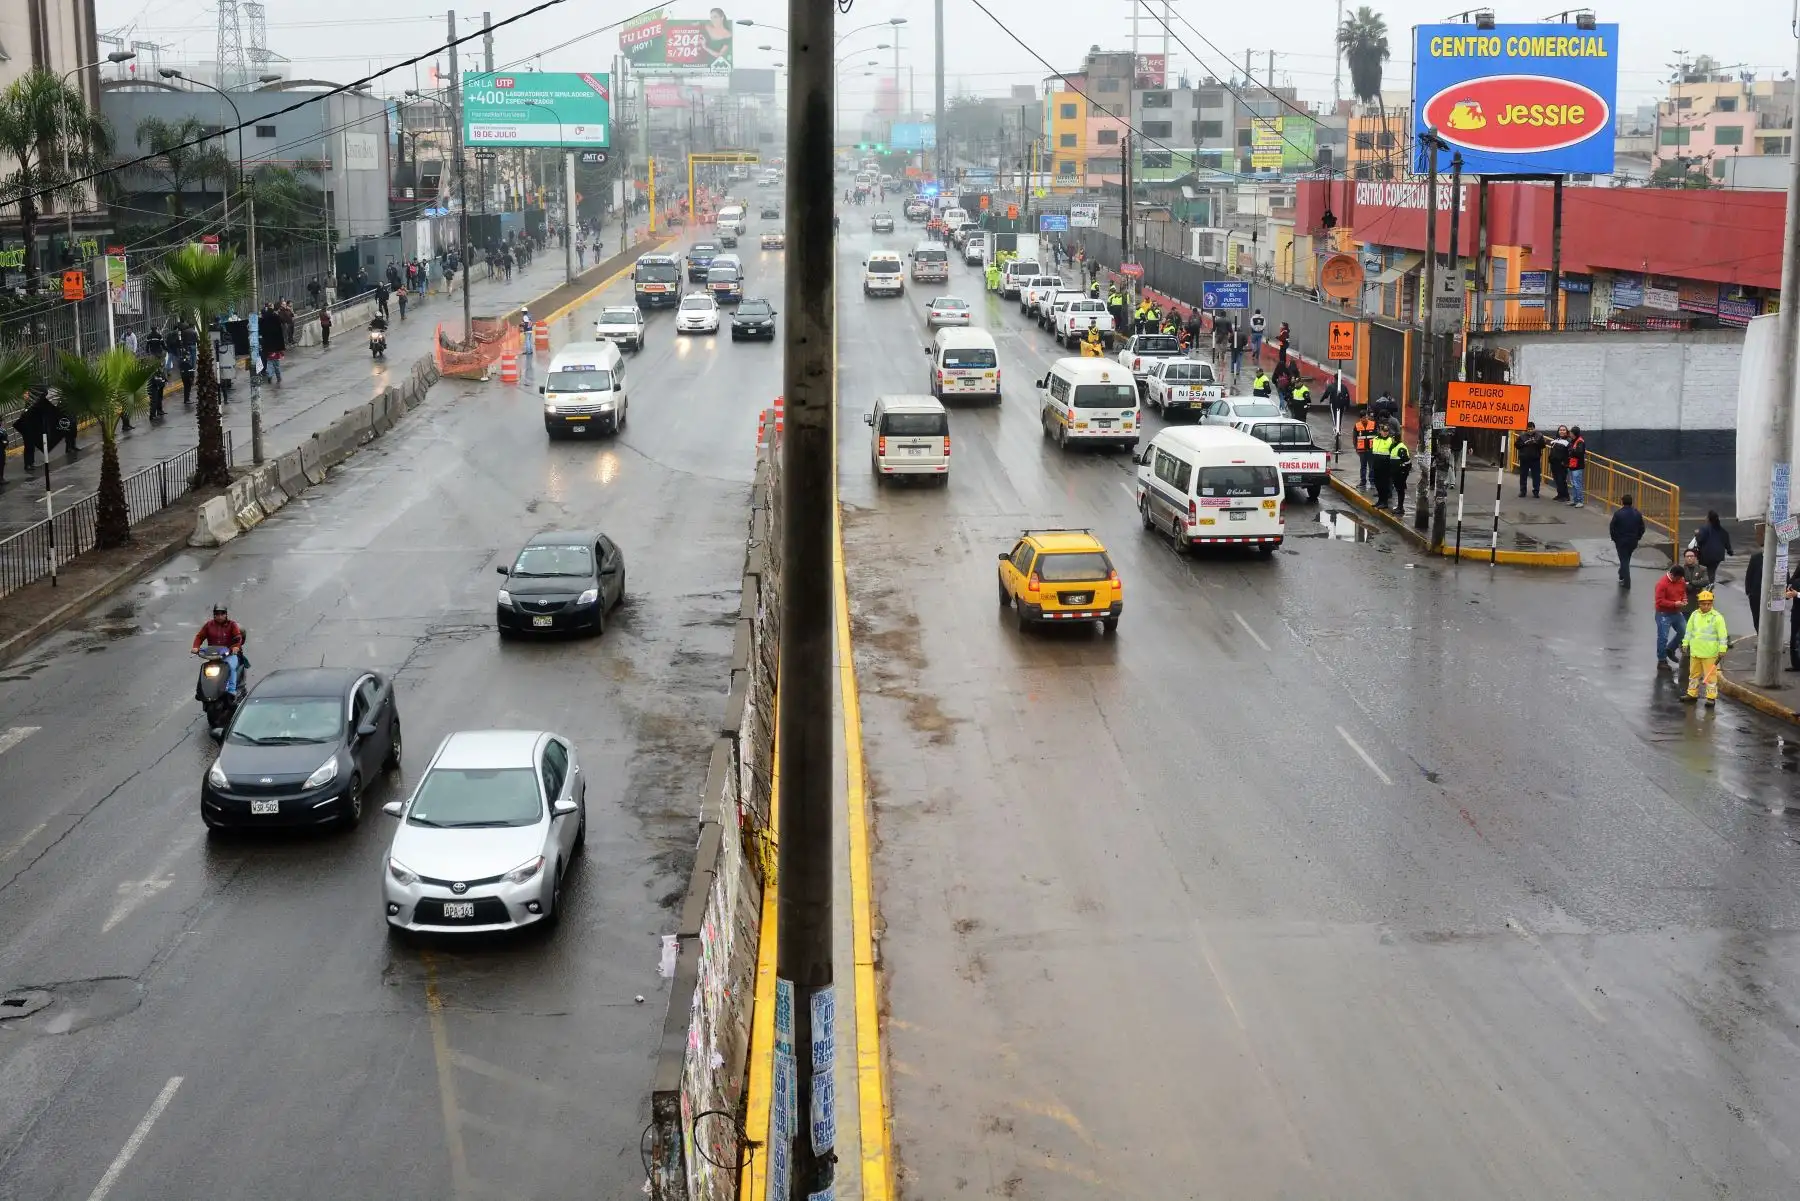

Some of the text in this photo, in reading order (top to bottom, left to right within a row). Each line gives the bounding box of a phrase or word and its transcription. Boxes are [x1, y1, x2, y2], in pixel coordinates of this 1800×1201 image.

[621, 24, 662, 44] TU LOTE
[1430, 36, 1608, 57] CENTRO COMERCIAL
[468, 78, 513, 88] EN LA UTP
[468, 90, 505, 104] +400
[582, 153, 597, 161] JMT
[1356, 182, 1384, 206] CENTRO
[1470, 387, 1504, 398] PELIGRO
[1450, 400, 1525, 412] ENTRADA Y SALIDA
[1460, 414, 1514, 424] DE CAMIONES
[1302, 462, 1320, 470] CIVIL
